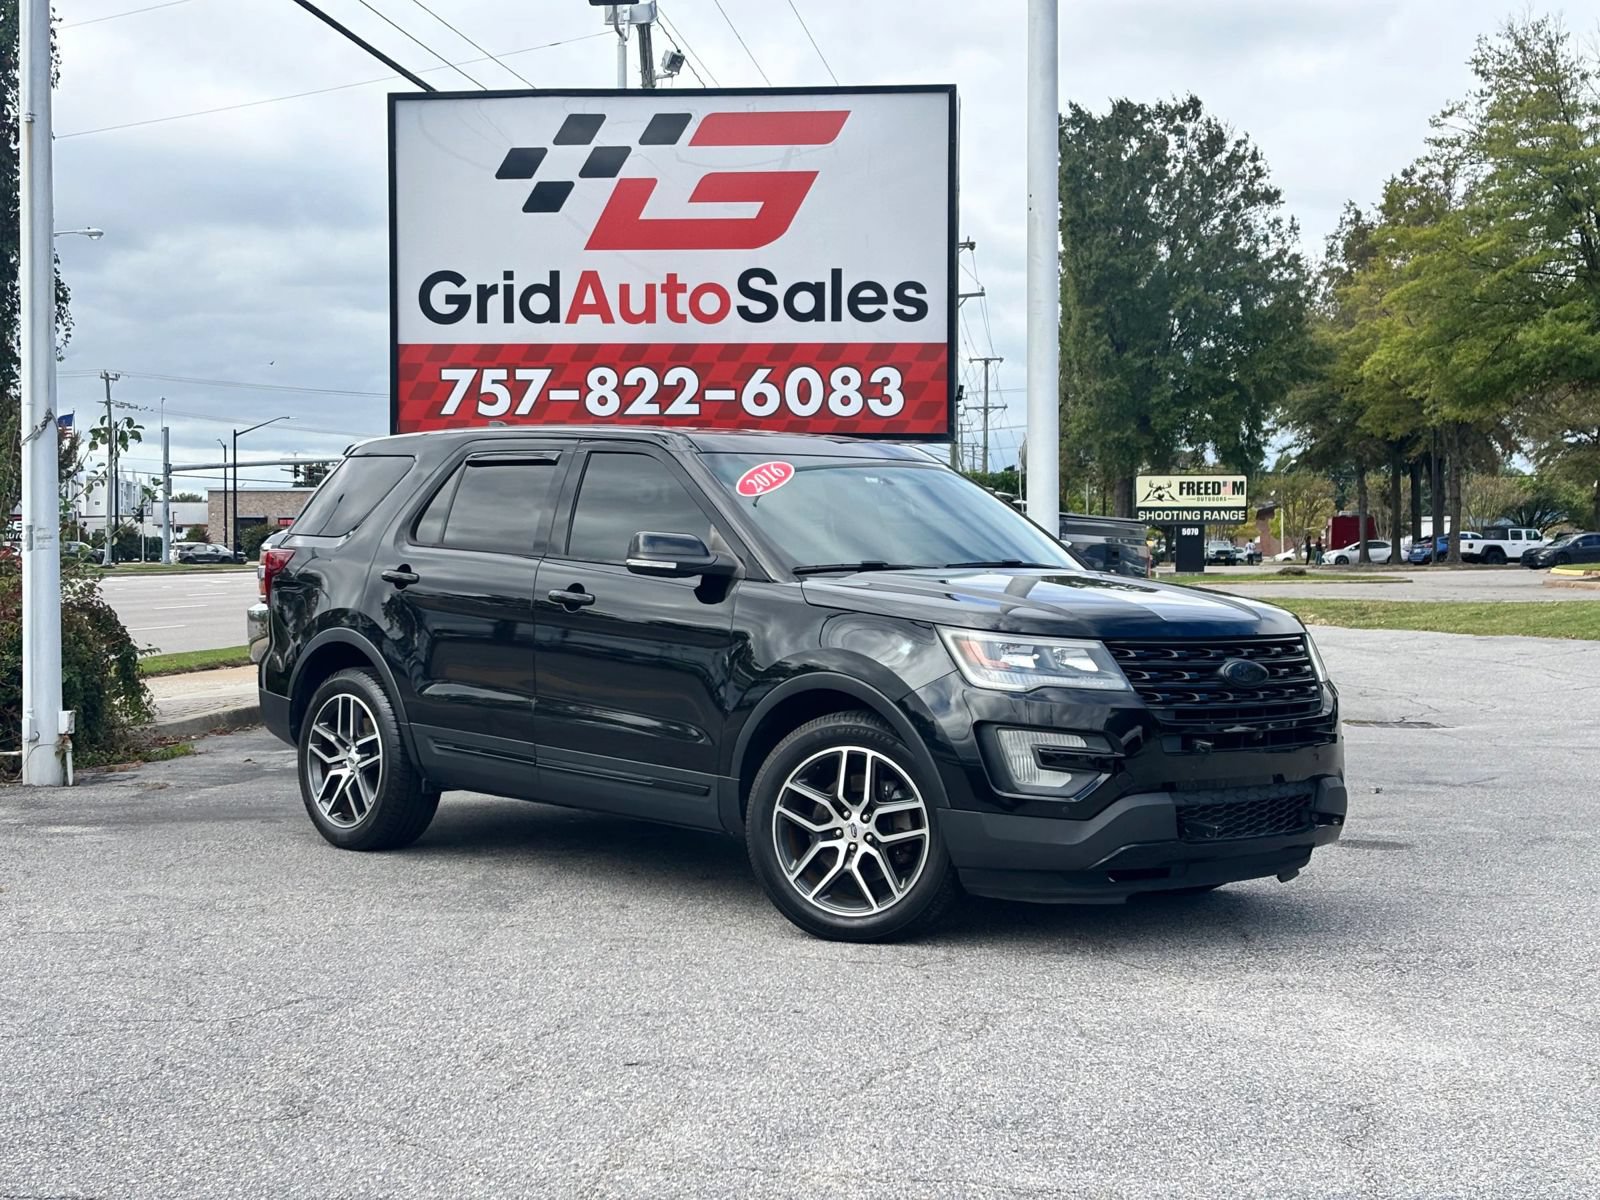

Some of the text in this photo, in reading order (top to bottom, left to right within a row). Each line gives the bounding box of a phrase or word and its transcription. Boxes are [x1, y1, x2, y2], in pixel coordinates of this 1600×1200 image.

[419, 268, 928, 325] GridAutoSales
[440, 367, 904, 417] 757-822-6083
[746, 464, 785, 493] 2016
[1178, 481, 1245, 496] FREEDM
[1137, 510, 1246, 521] SHOOTING RANGE
[1181, 527, 1199, 537] 5070
